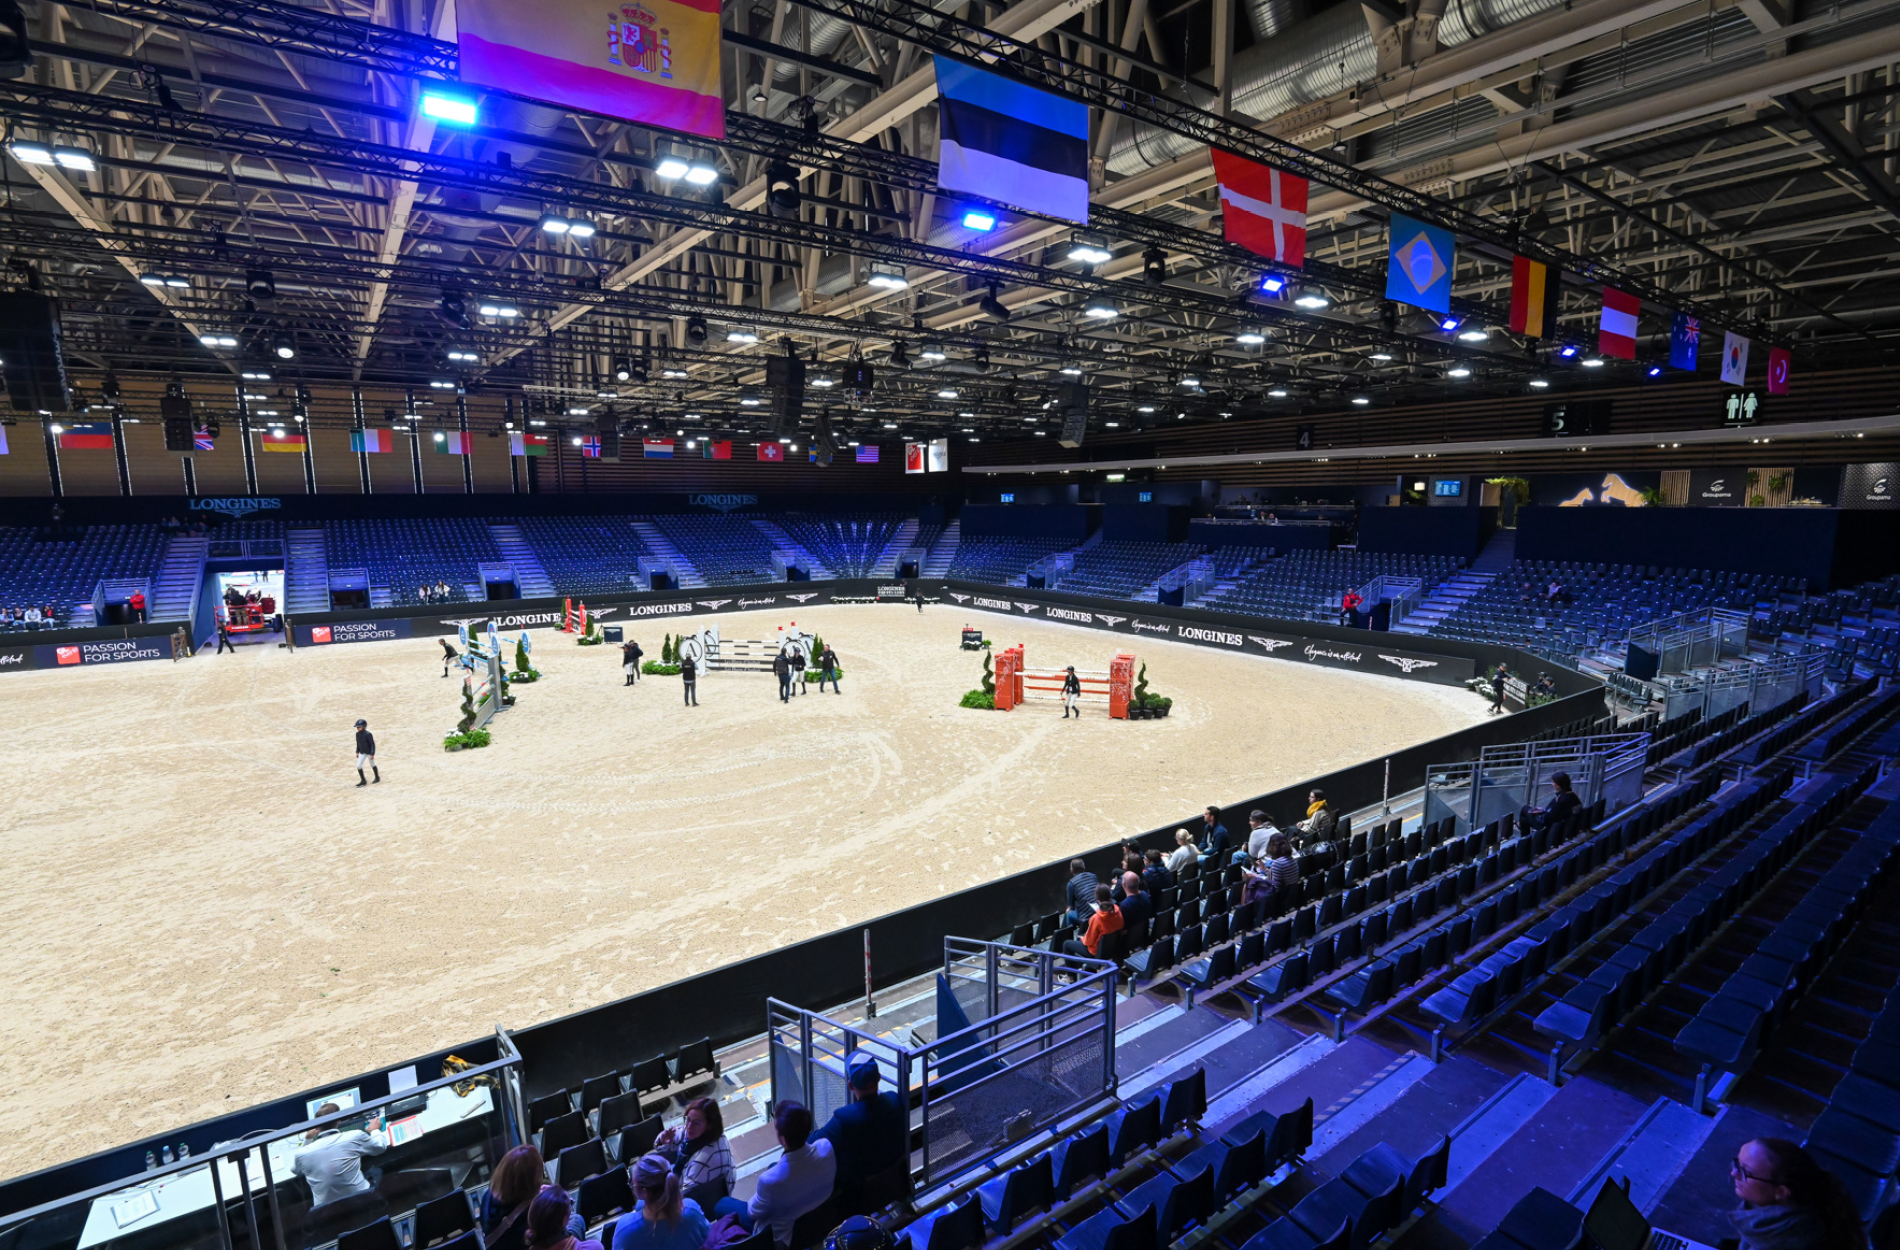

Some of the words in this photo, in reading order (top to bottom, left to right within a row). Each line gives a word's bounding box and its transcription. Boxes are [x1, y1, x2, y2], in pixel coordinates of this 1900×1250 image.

[1551, 412, 1565, 431] 5
[1299, 431, 1310, 448] 4
[190, 498, 282, 510] LONGINES
[688, 494, 758, 505] LONGINES
[629, 602, 692, 616] LONGINES
[973, 596, 1011, 611] LONGINES
[497, 612, 562, 627] LONGINE
[1046, 606, 1092, 623] LONGINES
[333, 623, 377, 633] PASSION
[334, 633, 356, 641] FOR
[358, 629, 396, 640] SPORTS
[1178, 626, 1243, 646] LONGINES
[83, 641, 137, 653] PASSION
[84, 653, 111, 663] FOR
[113, 648, 160, 661] SPORTS
